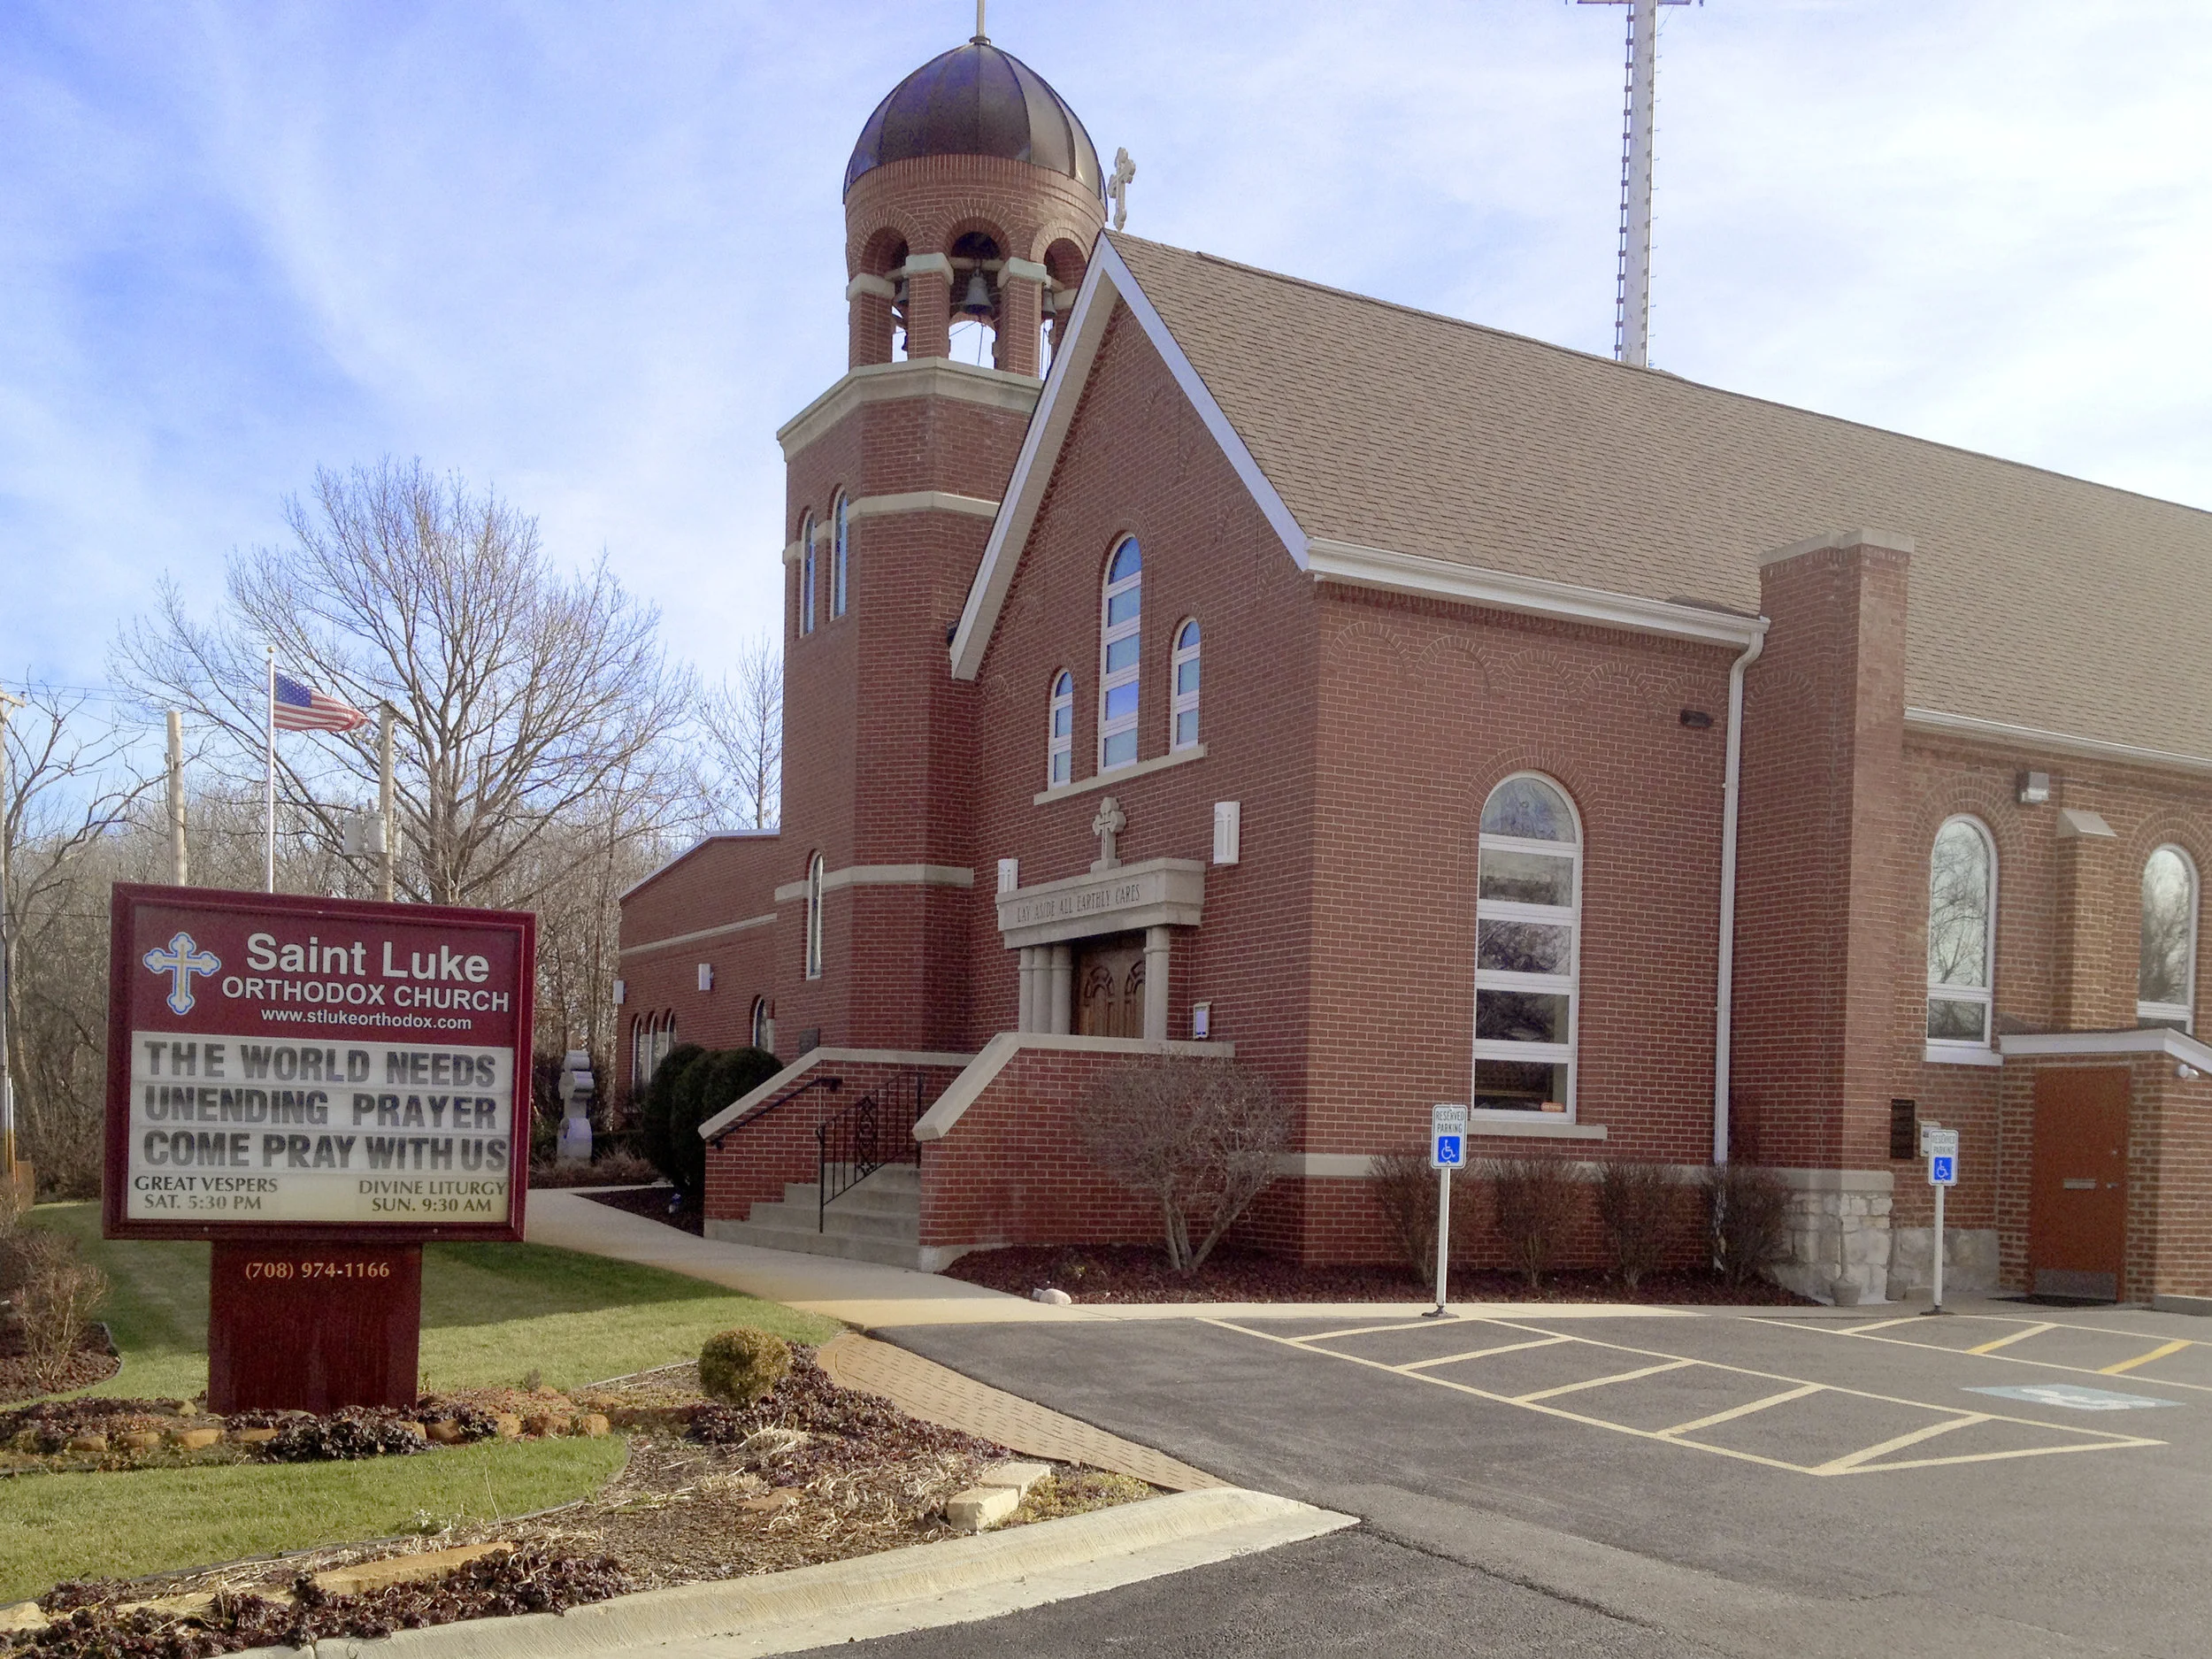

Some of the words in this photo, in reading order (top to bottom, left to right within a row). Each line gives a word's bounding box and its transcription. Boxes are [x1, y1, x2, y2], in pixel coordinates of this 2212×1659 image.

[1018, 906, 1031, 923] LAY
[1033, 901, 1056, 920] ASIDE
[1060, 896, 1073, 915] ALL
[1077, 889, 1111, 912] EARTHLY
[1115, 884, 1141, 903] CARES
[246, 932, 366, 976] Saint
[382, 941, 490, 983] Luke
[221, 977, 386, 1006] ORTHODOX
[393, 987, 509, 1012] CHURCH
[261, 1008, 472, 1030] www.stlukeorthodox.com
[143, 1041, 226, 1077] THE
[240, 1044, 370, 1082] WORLD
[386, 1051, 495, 1087] NEEDS
[144, 1085, 328, 1125] UNENDING
[352, 1093, 497, 1130] PRAYER
[1436, 1110, 1464, 1121] RESERVED
[1437, 1123, 1463, 1133] PARKING
[143, 1130, 250, 1167] COME
[263, 1134, 357, 1170] PRAY
[365, 1136, 453, 1171] WITH
[461, 1138, 507, 1172] US
[134, 1175, 196, 1192] GREAT
[202, 1177, 278, 1194] VESPERS
[358, 1179, 426, 1195] DIVINE
[428, 1179, 508, 1196] LITURGY
[143, 1194, 181, 1210] SAT.
[188, 1194, 227, 1210] 5:30
[234, 1195, 262, 1210] PM
[372, 1197, 417, 1212] SUN.
[422, 1197, 458, 1213] 9:30
[463, 1198, 492, 1213] AM
[245, 1262, 295, 1279] (708)
[302, 1262, 390, 1279] 974-1166
